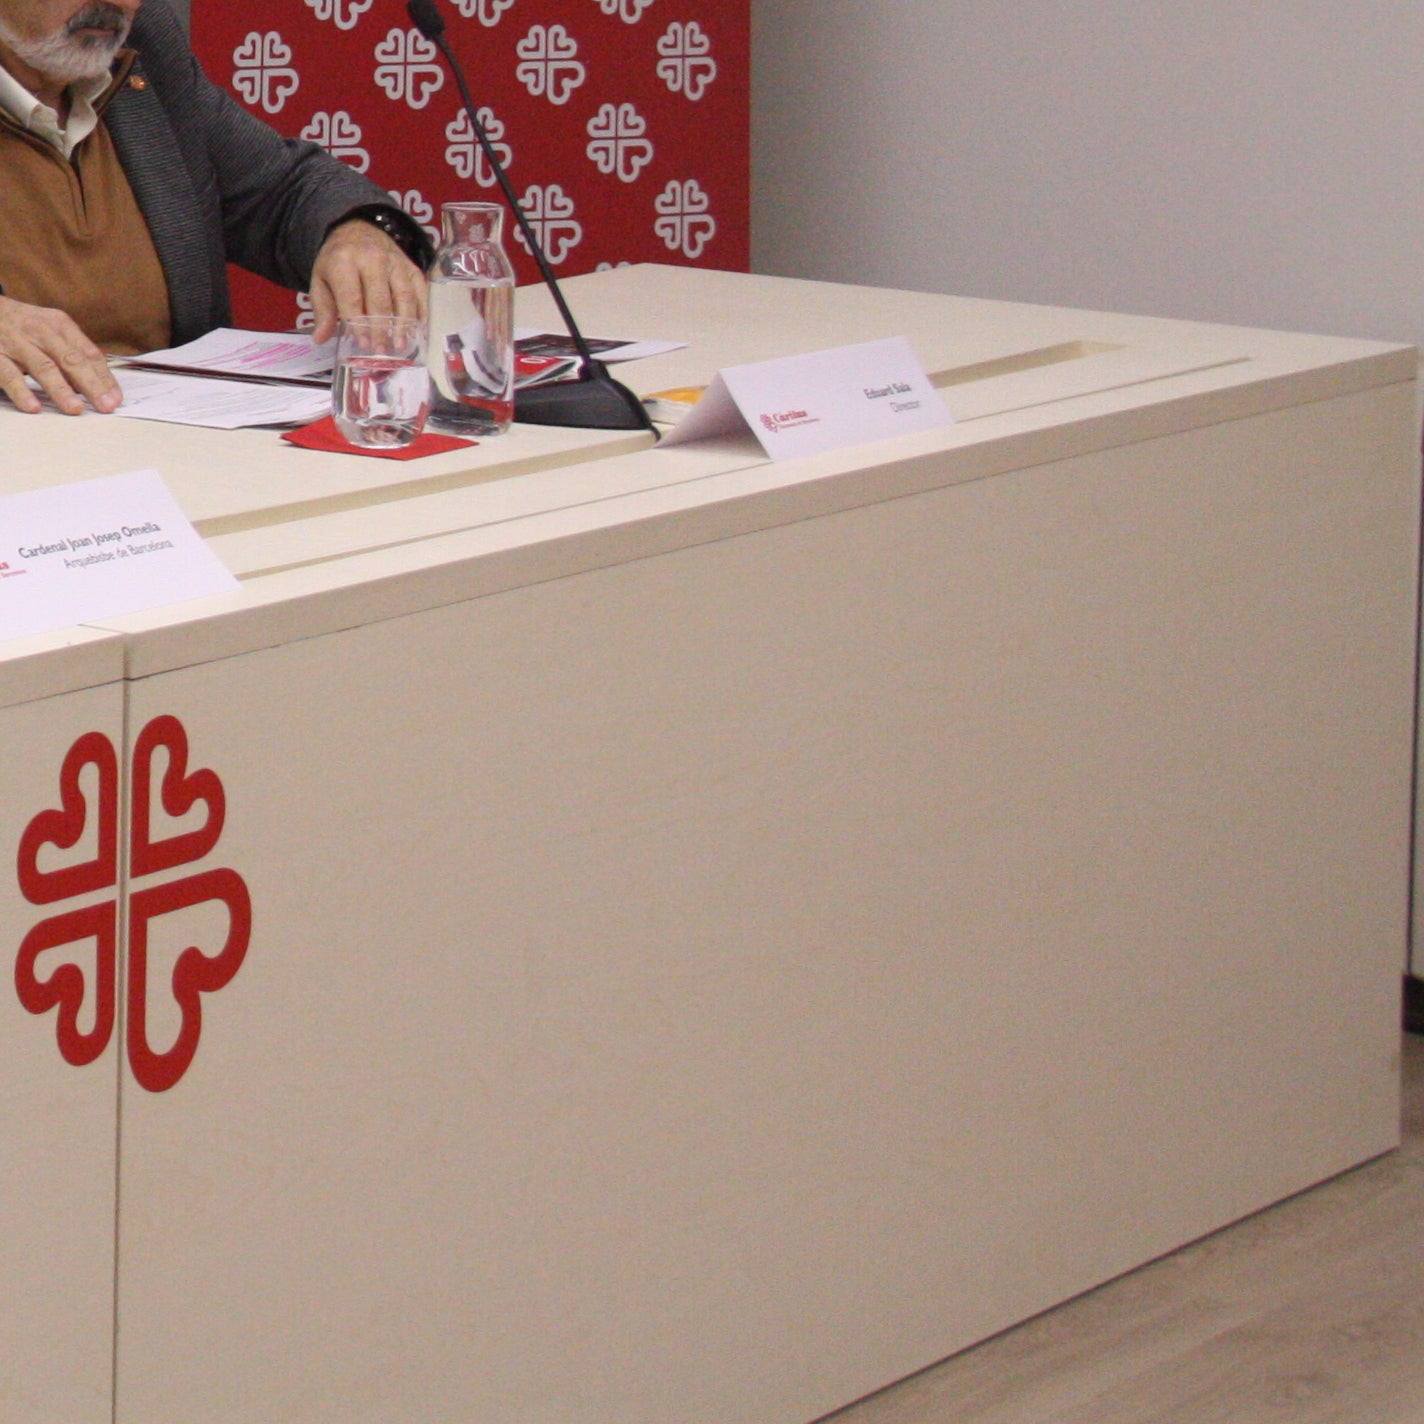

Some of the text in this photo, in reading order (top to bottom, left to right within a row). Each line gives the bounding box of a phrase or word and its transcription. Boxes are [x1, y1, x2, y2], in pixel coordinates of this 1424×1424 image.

[18, 540, 68, 559] Cardenal
[67, 536, 93, 553] Joan
[92, 531, 123, 548] Josep
